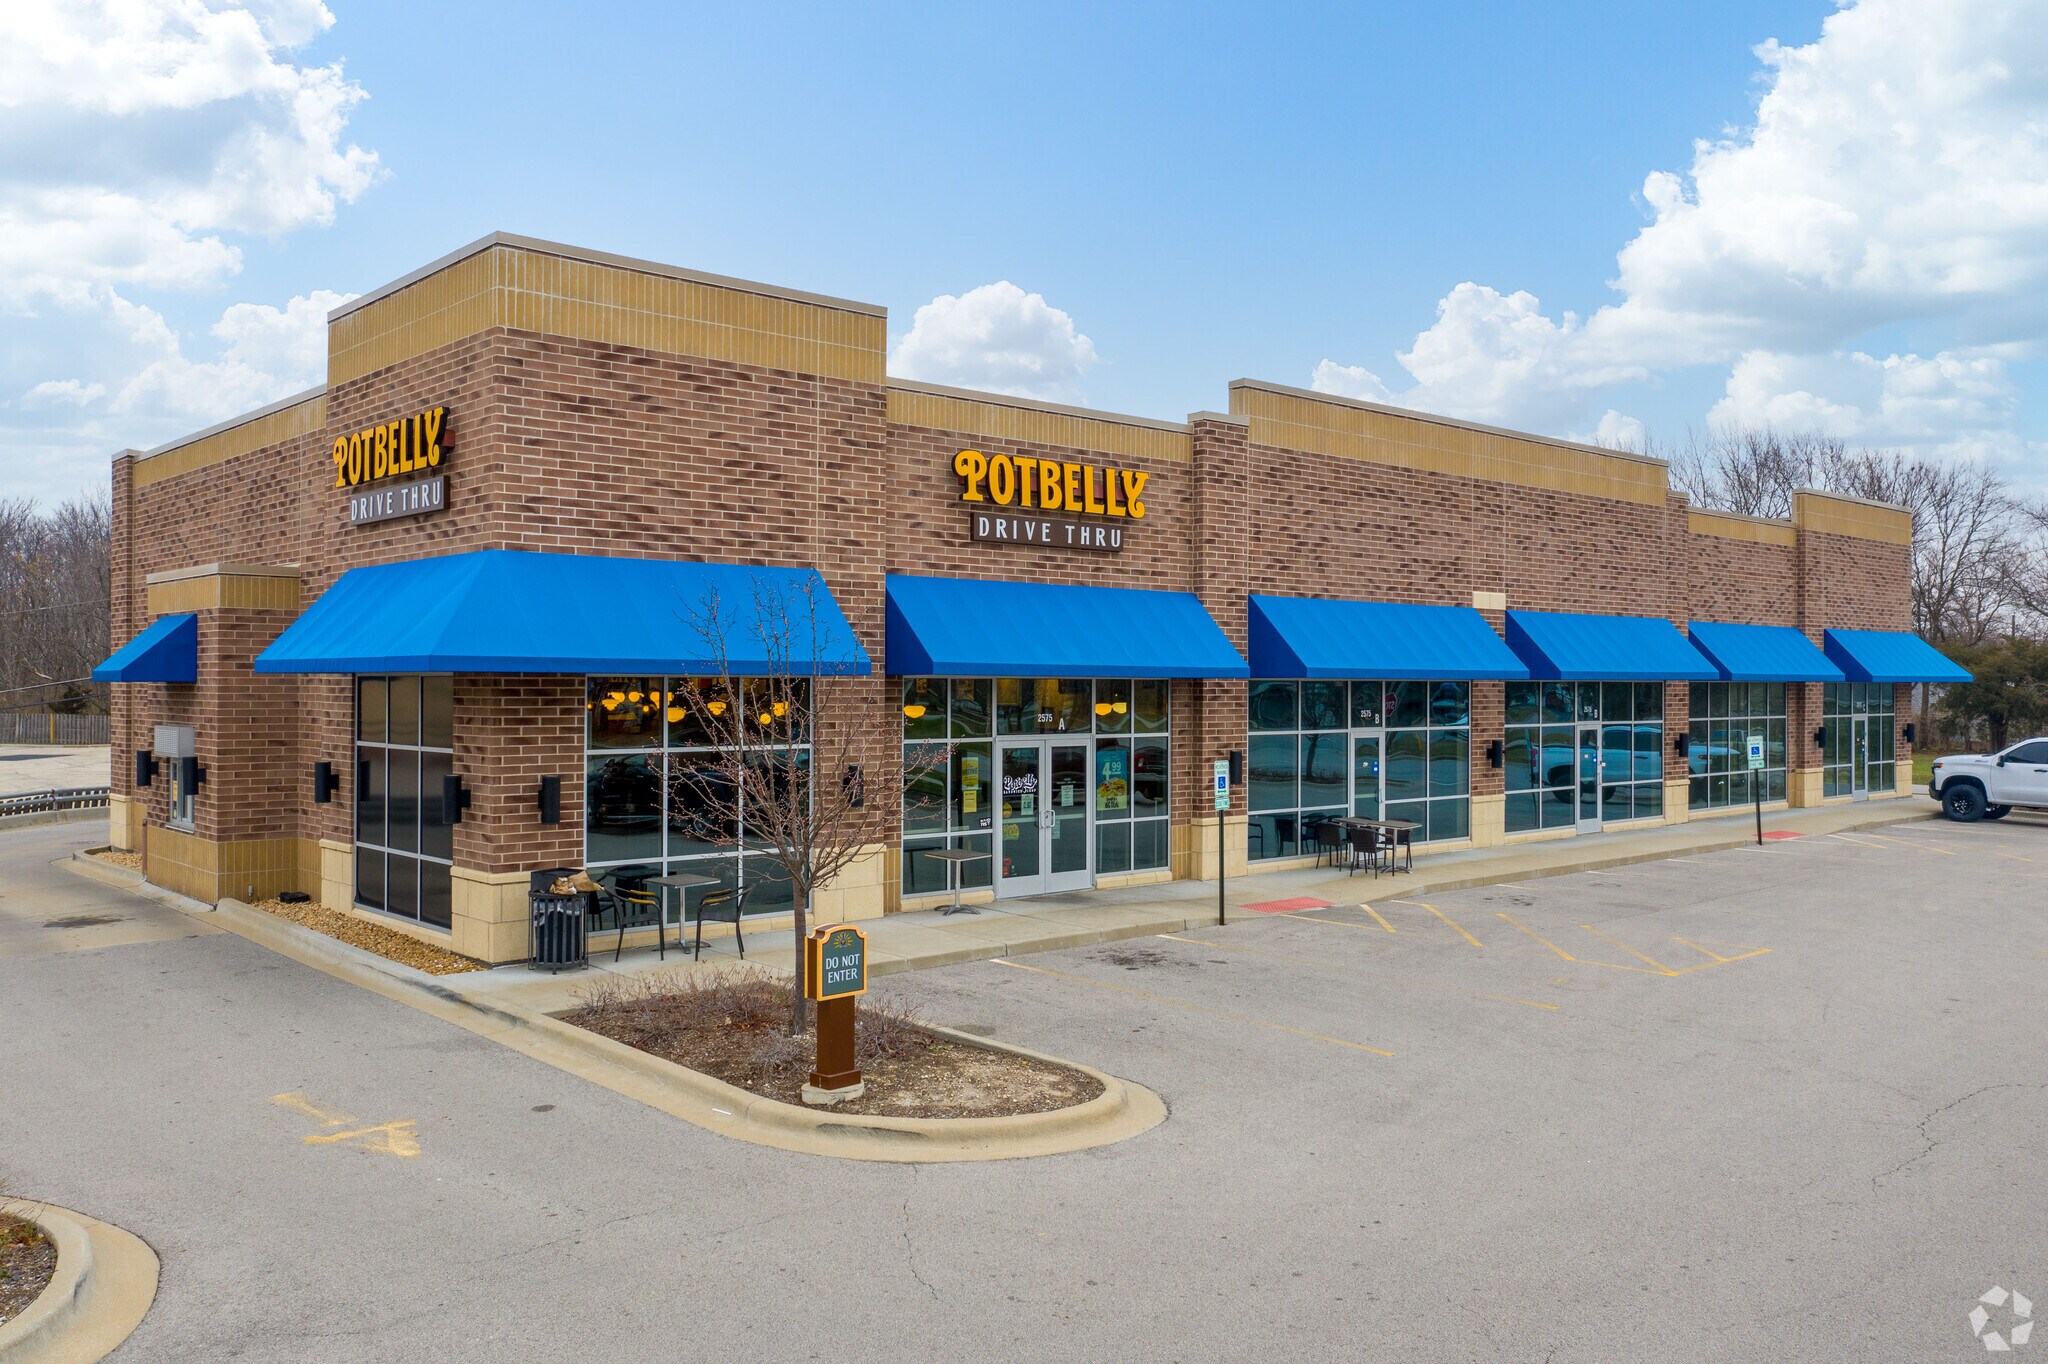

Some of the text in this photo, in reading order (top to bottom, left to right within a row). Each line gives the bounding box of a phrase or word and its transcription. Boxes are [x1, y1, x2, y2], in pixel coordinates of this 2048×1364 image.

[333, 406, 447, 488] POTBELLY
[953, 449, 1150, 519] POTBELLY
[351, 481, 441, 521] DRIVE THRU
[978, 516, 1121, 548] DRIVE THRU
[1037, 713, 1053, 723] 2575
[1360, 709, 1372, 718] 2575
[1374, 713, 1380, 724] B
[1058, 717, 1066, 731] A
[826, 954, 860, 969] DO NOT
[828, 968, 858, 983] ENTER
